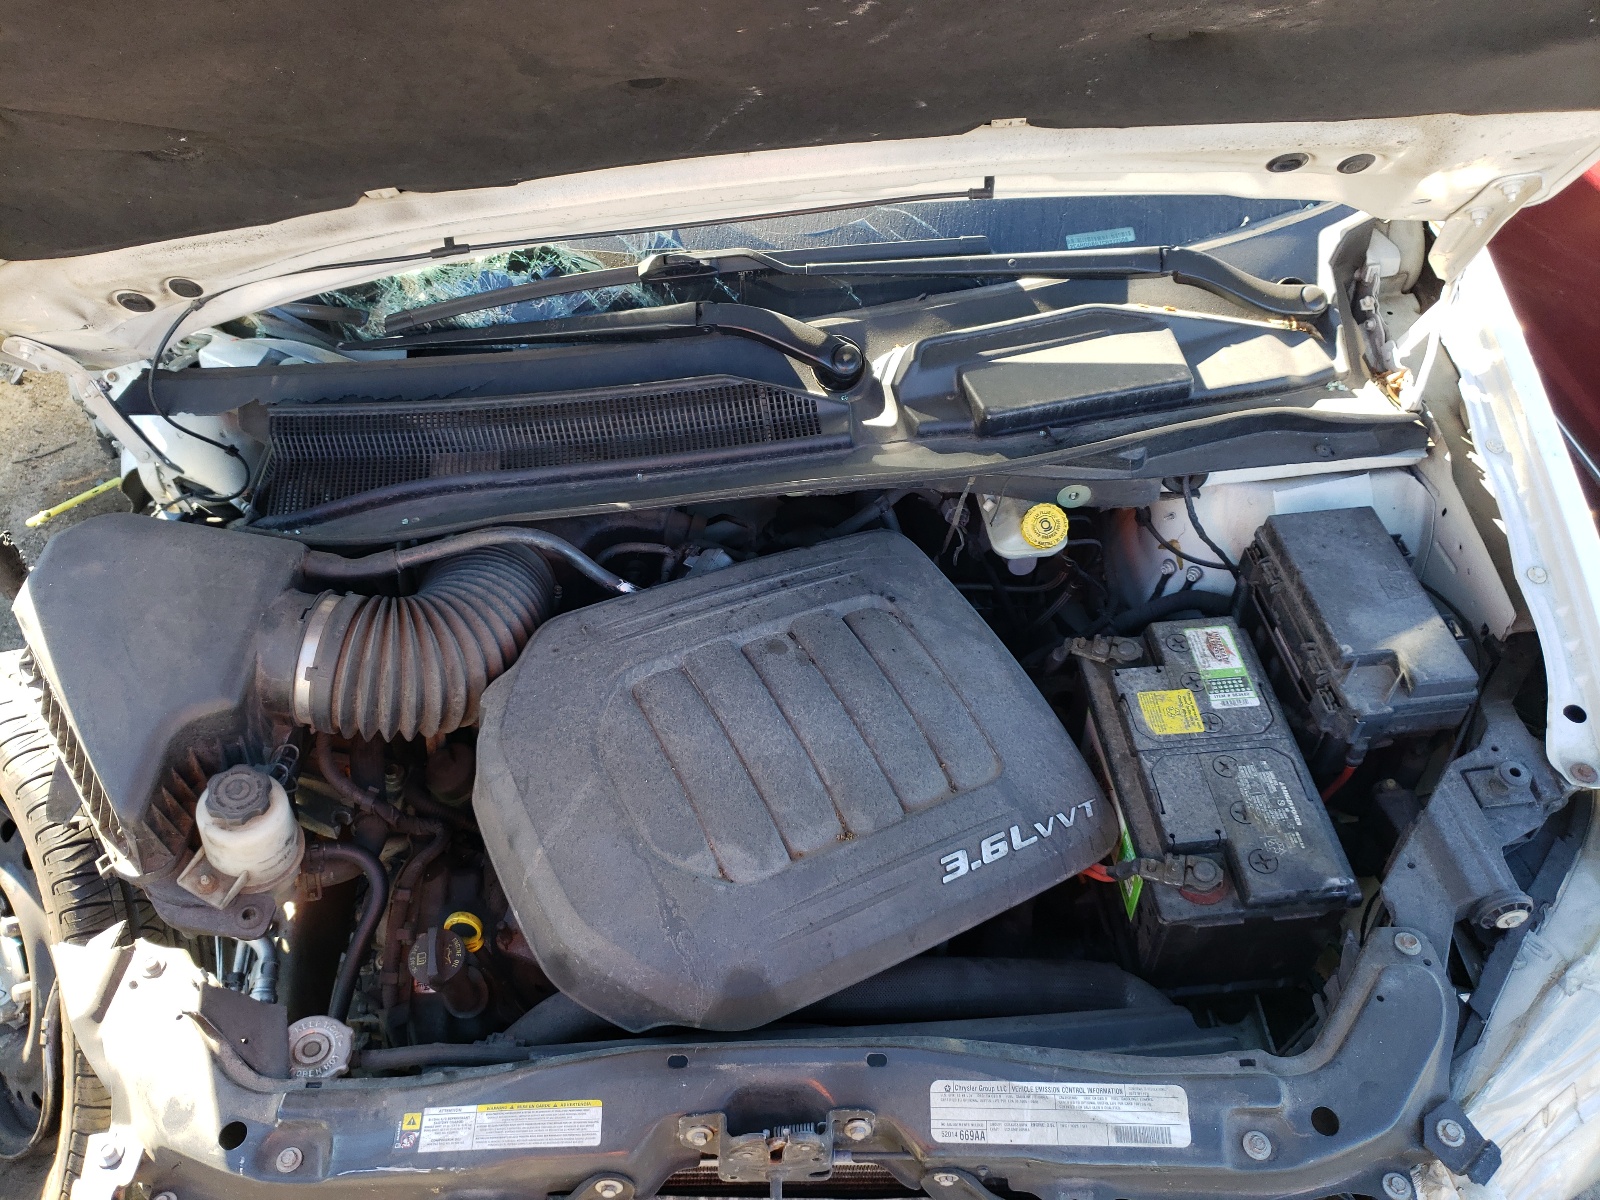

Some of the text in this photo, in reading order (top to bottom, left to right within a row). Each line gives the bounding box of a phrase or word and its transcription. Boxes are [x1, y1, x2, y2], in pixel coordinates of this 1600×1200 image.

[940, 798, 1096, 884] 3.6L VVT
[452, 938, 462, 957] ENGINE
[294, 1020, 321, 1033] KEEP
[296, 1054, 339, 1077] OPEN HOT
[954, 1084, 977, 1092] Chrysler
[978, 1085, 995, 1093] Group
[941, 1129, 986, 1141] 52014 669AA
